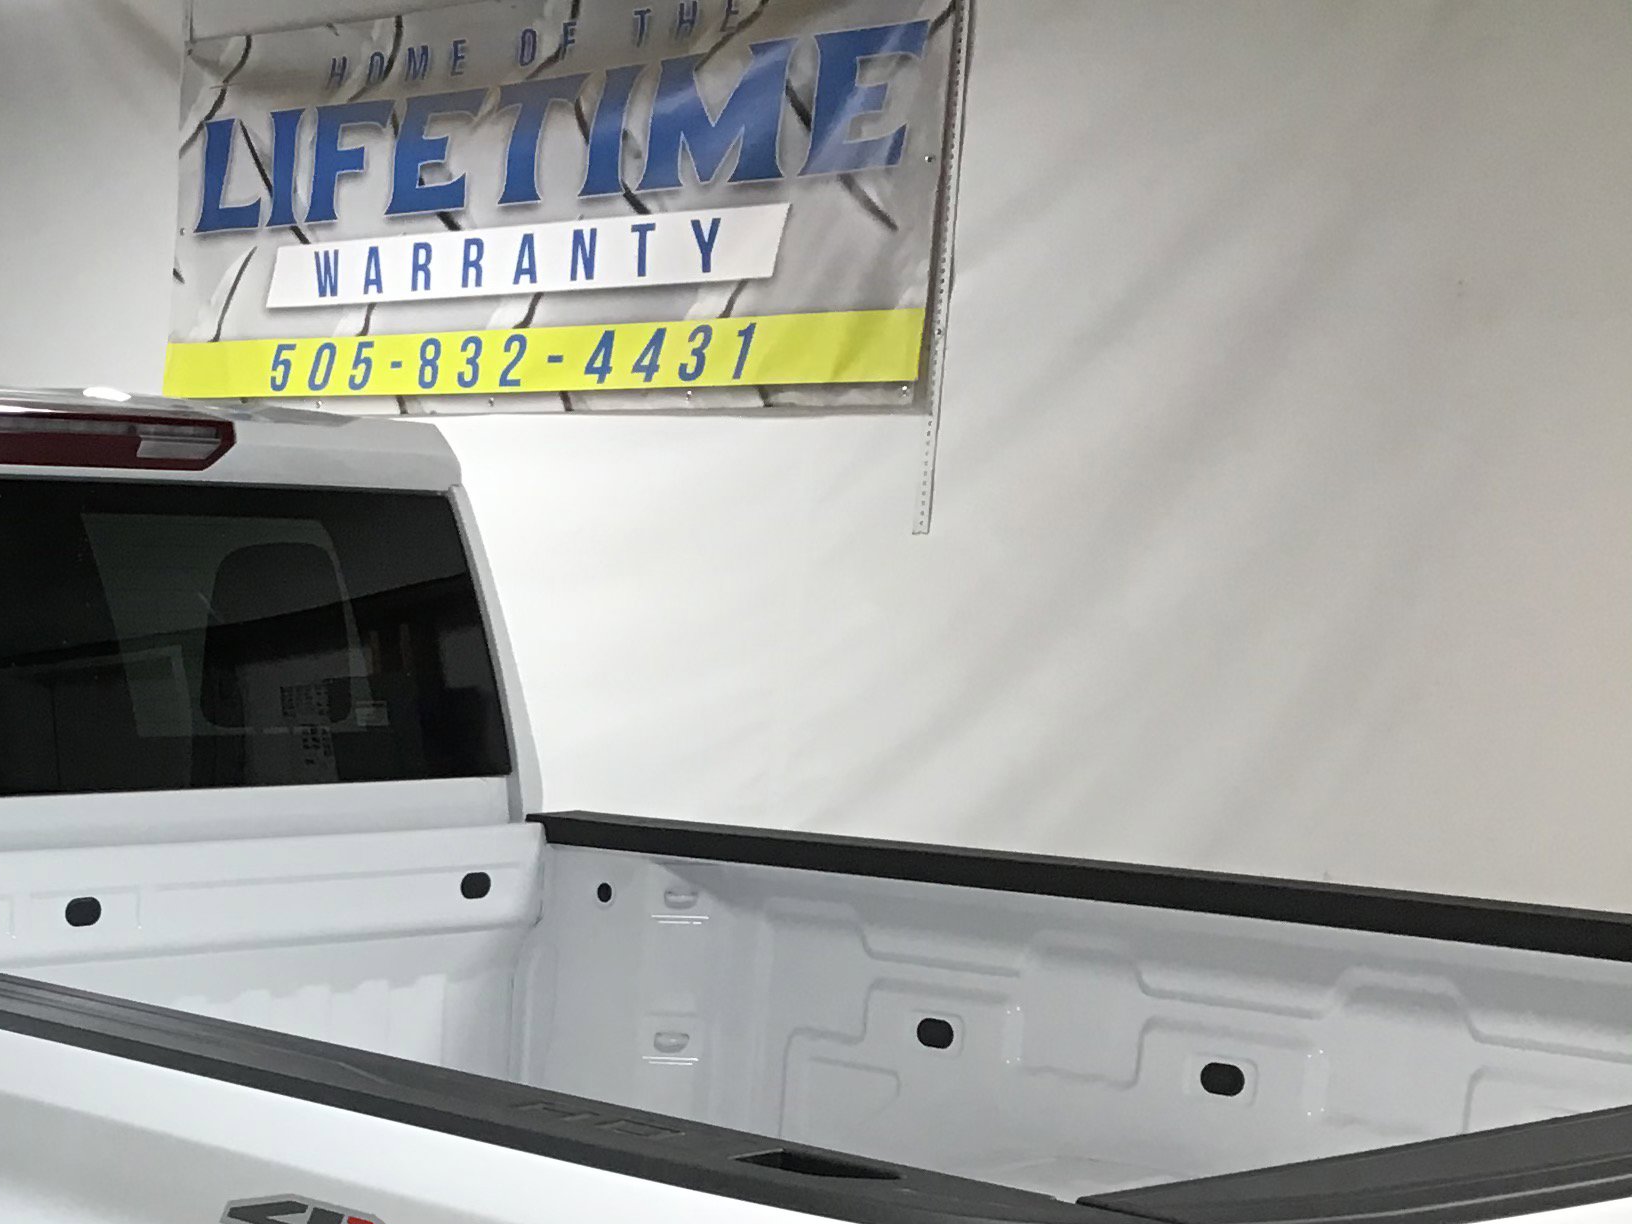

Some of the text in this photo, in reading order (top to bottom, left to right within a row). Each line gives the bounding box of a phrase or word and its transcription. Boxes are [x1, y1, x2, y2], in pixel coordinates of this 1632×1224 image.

[329, 0, 741, 88] HOME OF THE
[193, 18, 930, 236] LIFETIME
[313, 216, 724, 300] WARRANTY
[270, 321, 758, 392] 505-832-4431
